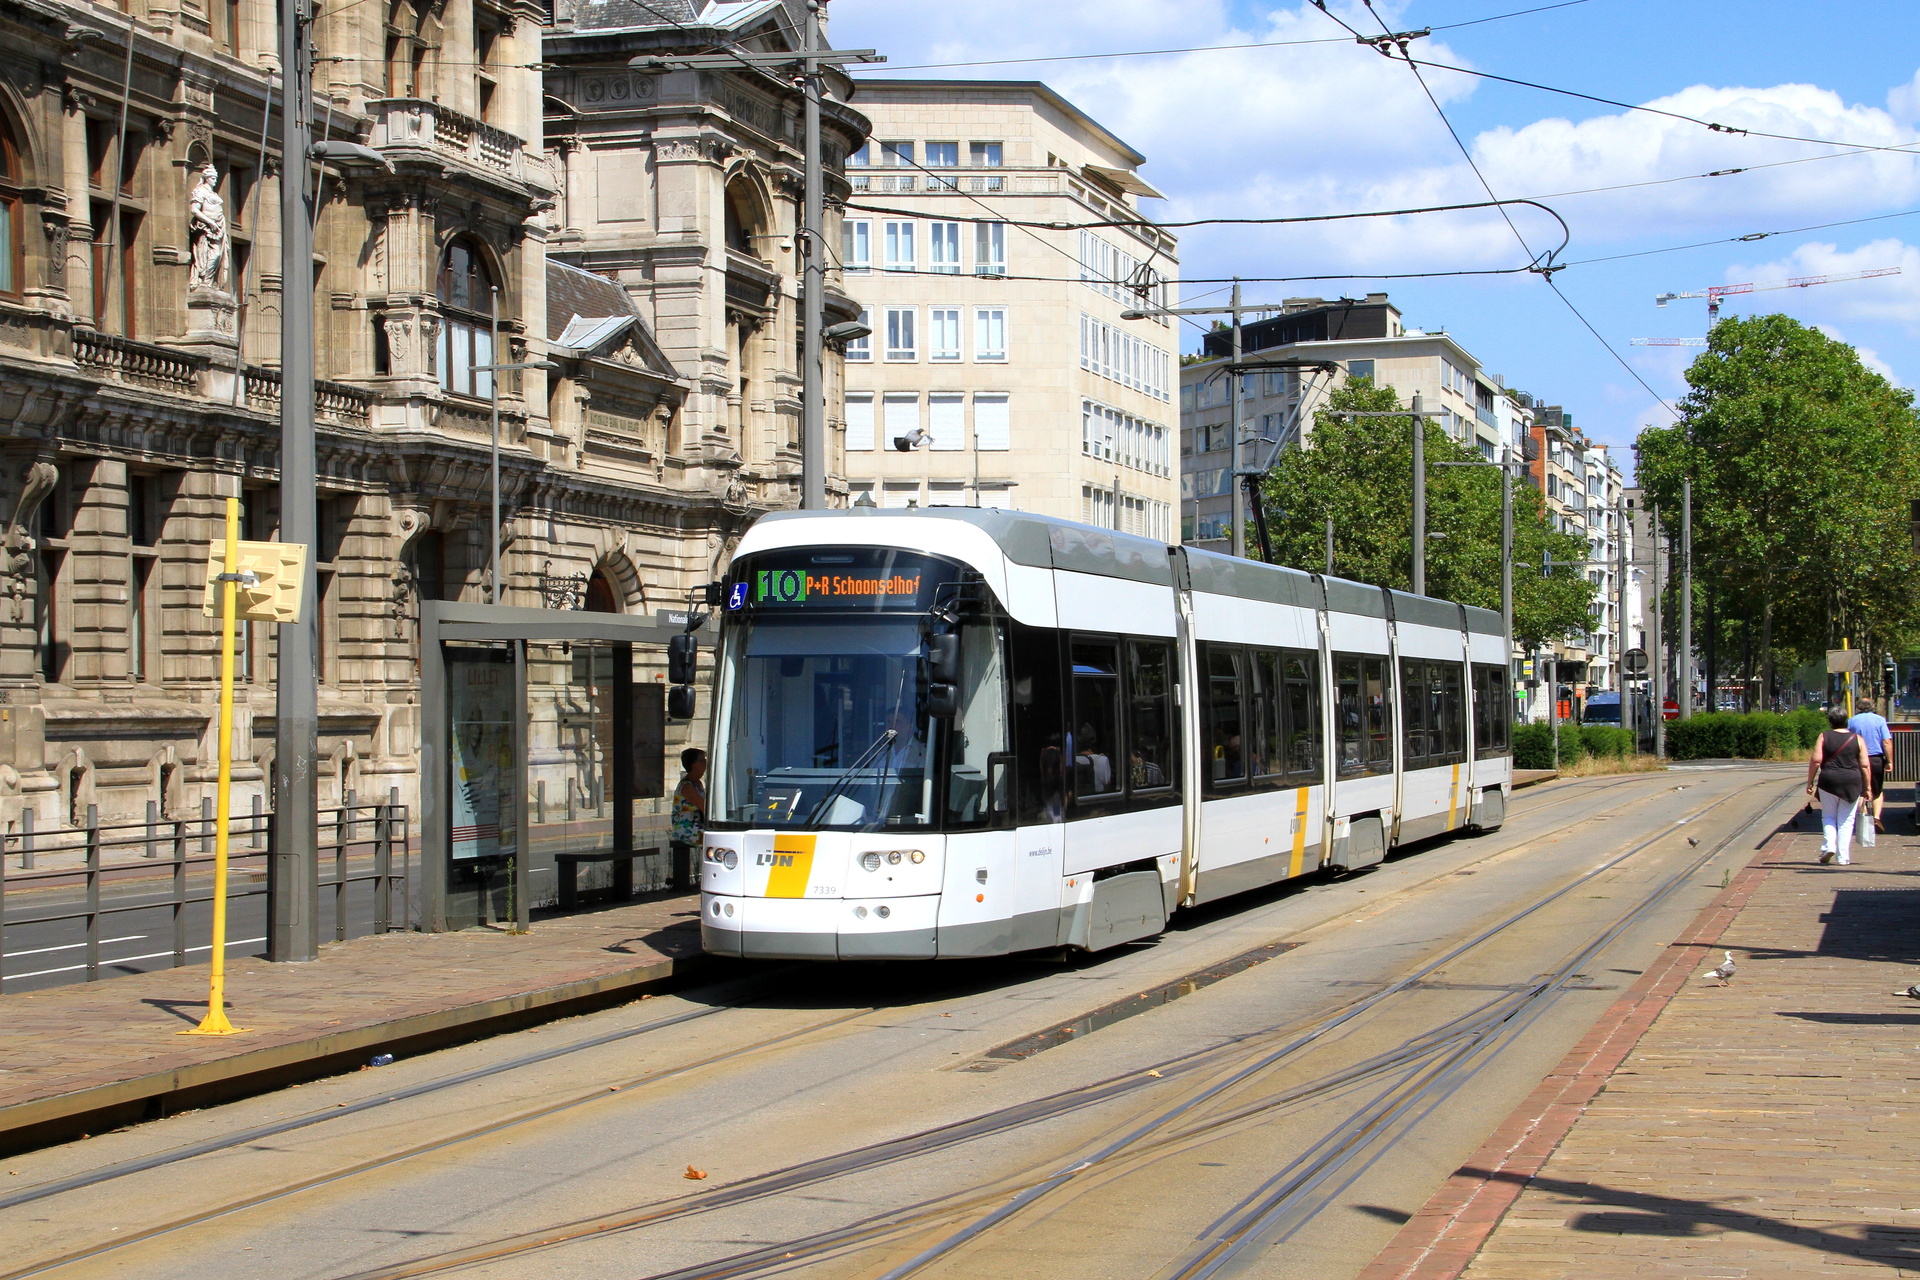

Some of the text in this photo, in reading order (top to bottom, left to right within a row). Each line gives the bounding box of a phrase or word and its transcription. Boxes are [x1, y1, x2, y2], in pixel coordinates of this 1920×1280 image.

[761, 571, 920, 601] 10 P+R Schoonselhof
[467, 668, 500, 686] LILLET
[813, 885, 836, 895] 7339
